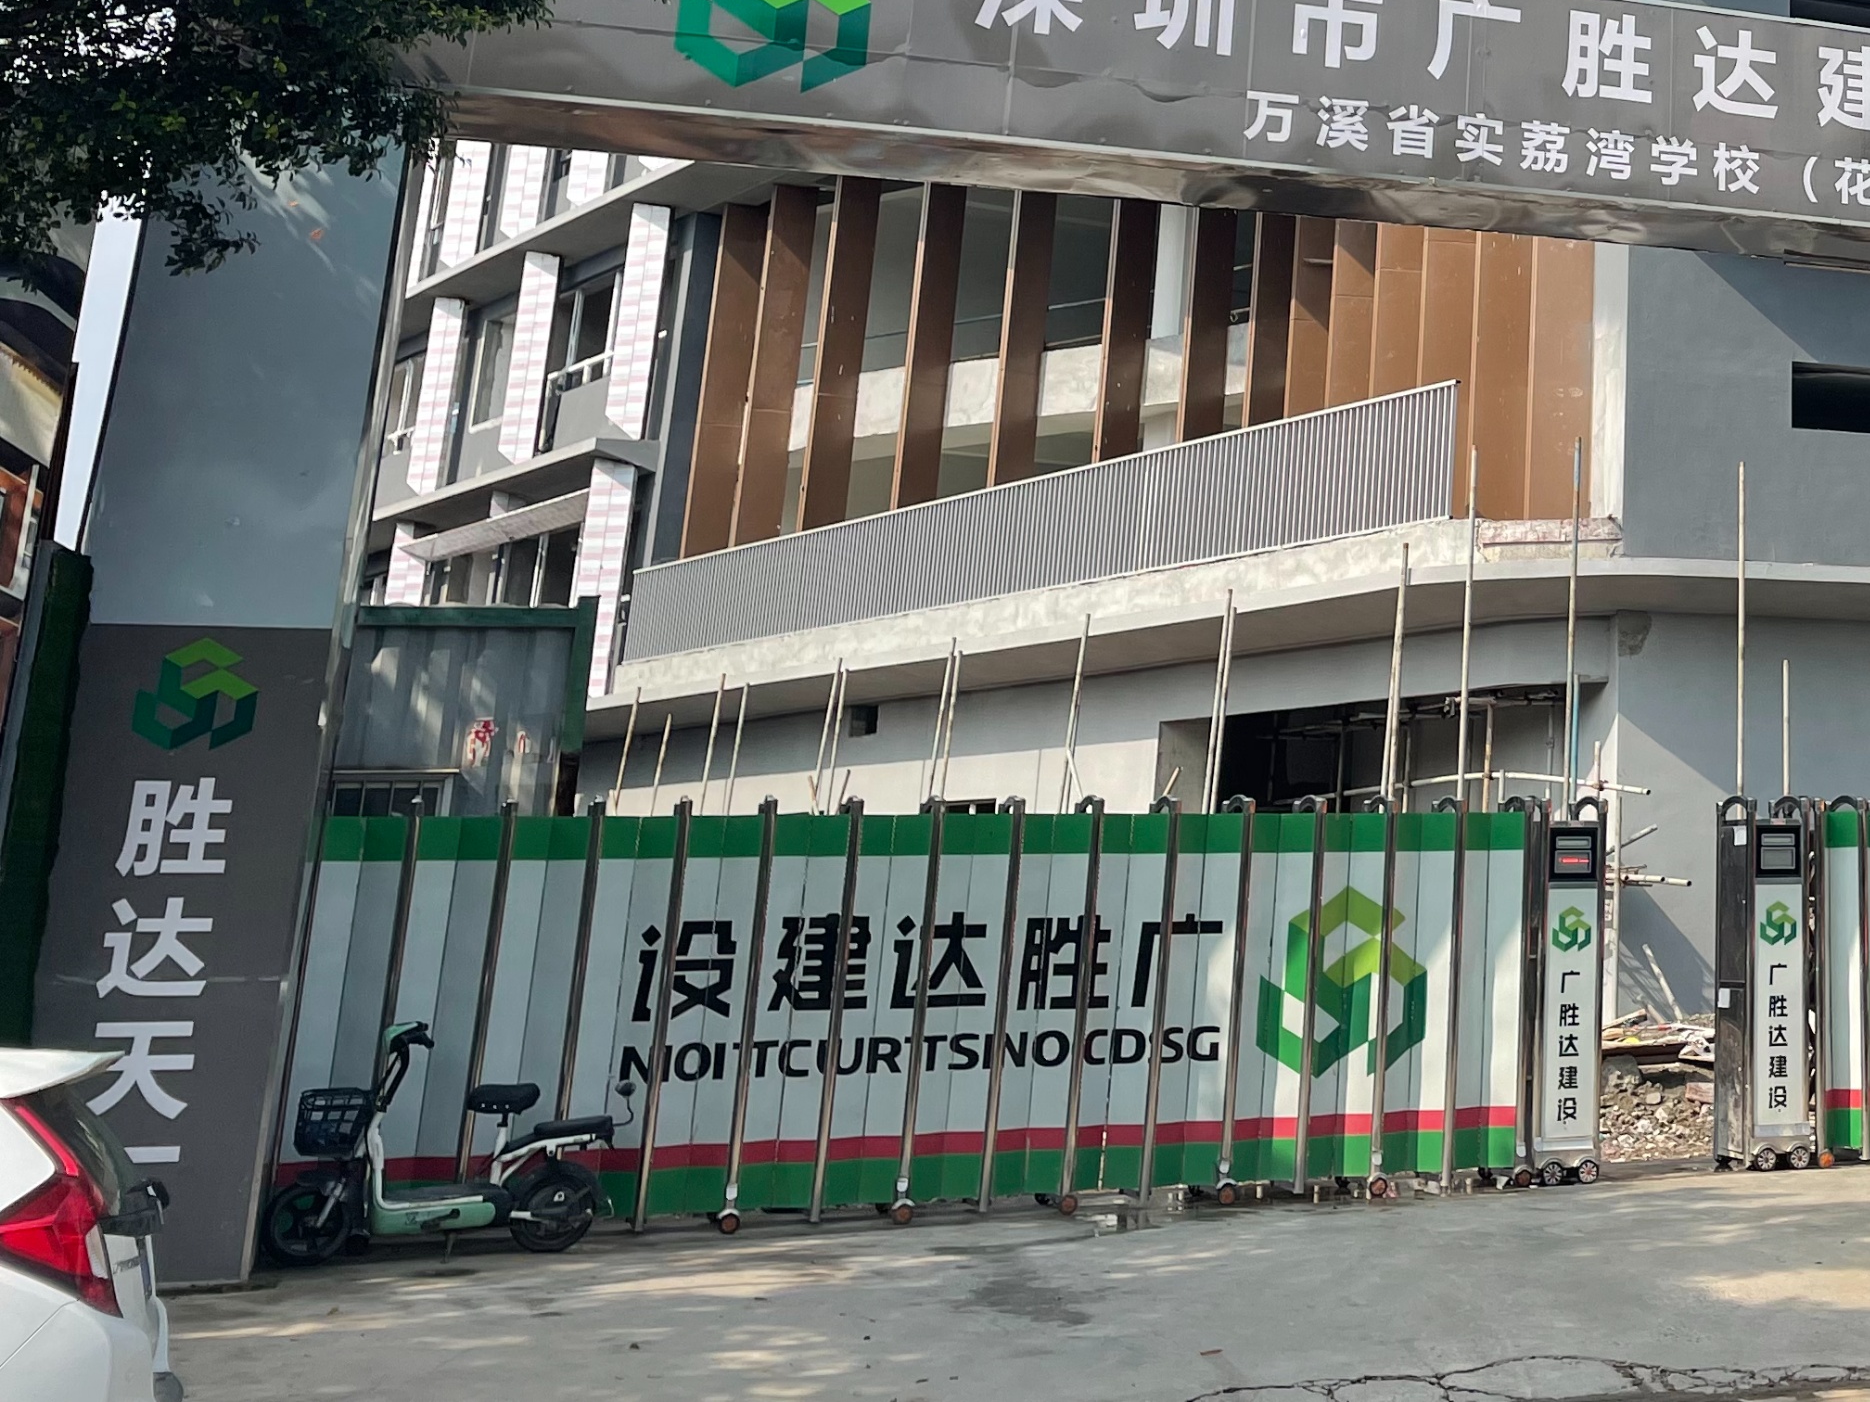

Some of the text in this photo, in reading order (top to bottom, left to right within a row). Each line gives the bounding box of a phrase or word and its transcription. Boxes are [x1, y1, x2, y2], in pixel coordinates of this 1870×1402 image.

[85, 776, 233, 1164] 胜达天
[1557, 970, 1581, 1121] 广胜达建设
[1768, 963, 1788, 1109] 广胜达建设
